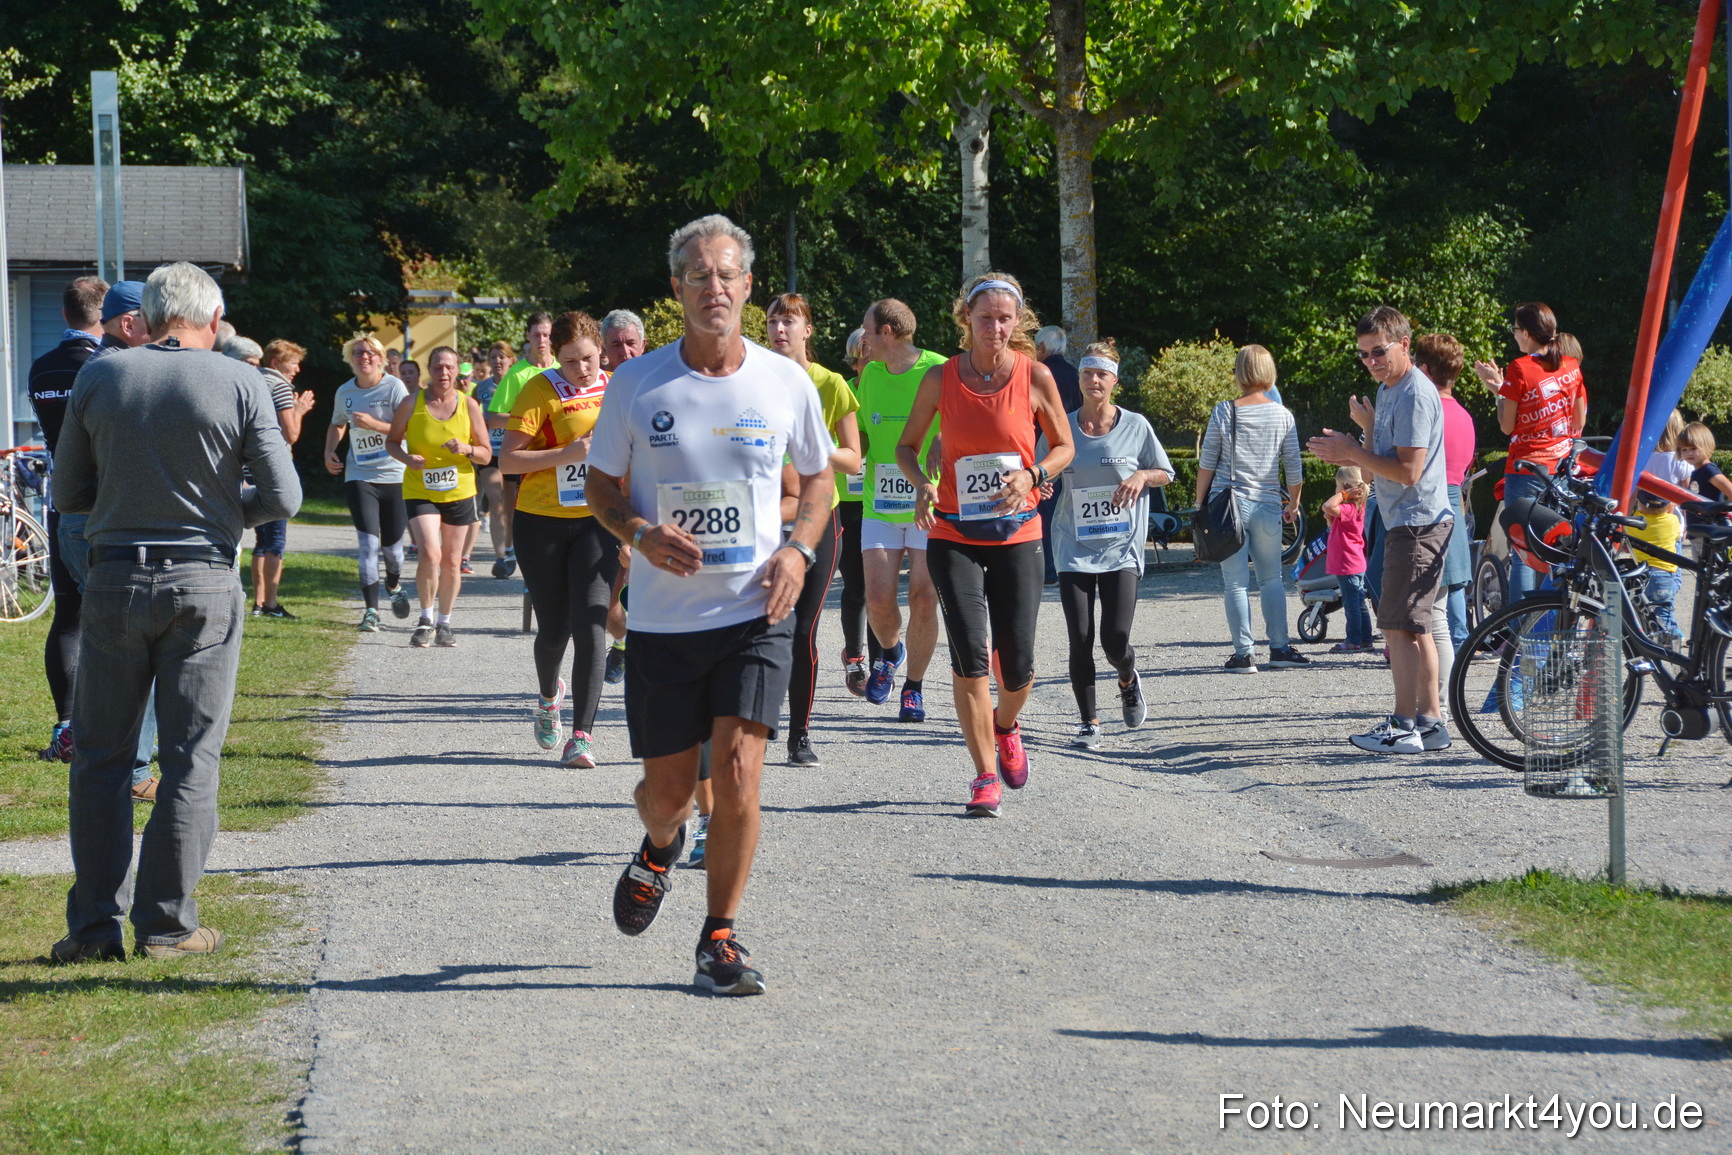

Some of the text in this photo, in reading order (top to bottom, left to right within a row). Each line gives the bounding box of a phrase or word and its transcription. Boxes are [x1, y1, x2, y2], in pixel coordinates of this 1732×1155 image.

[564, 401, 592, 415] MAX
[356, 434, 384, 450] 2106
[649, 433, 679, 443] PARTL
[425, 469, 456, 484] 3042
[880, 477, 915, 494] 2166
[683, 489, 726, 502] BOCK
[672, 506, 741, 535] 2288
[1088, 525, 1118, 534] Christina
